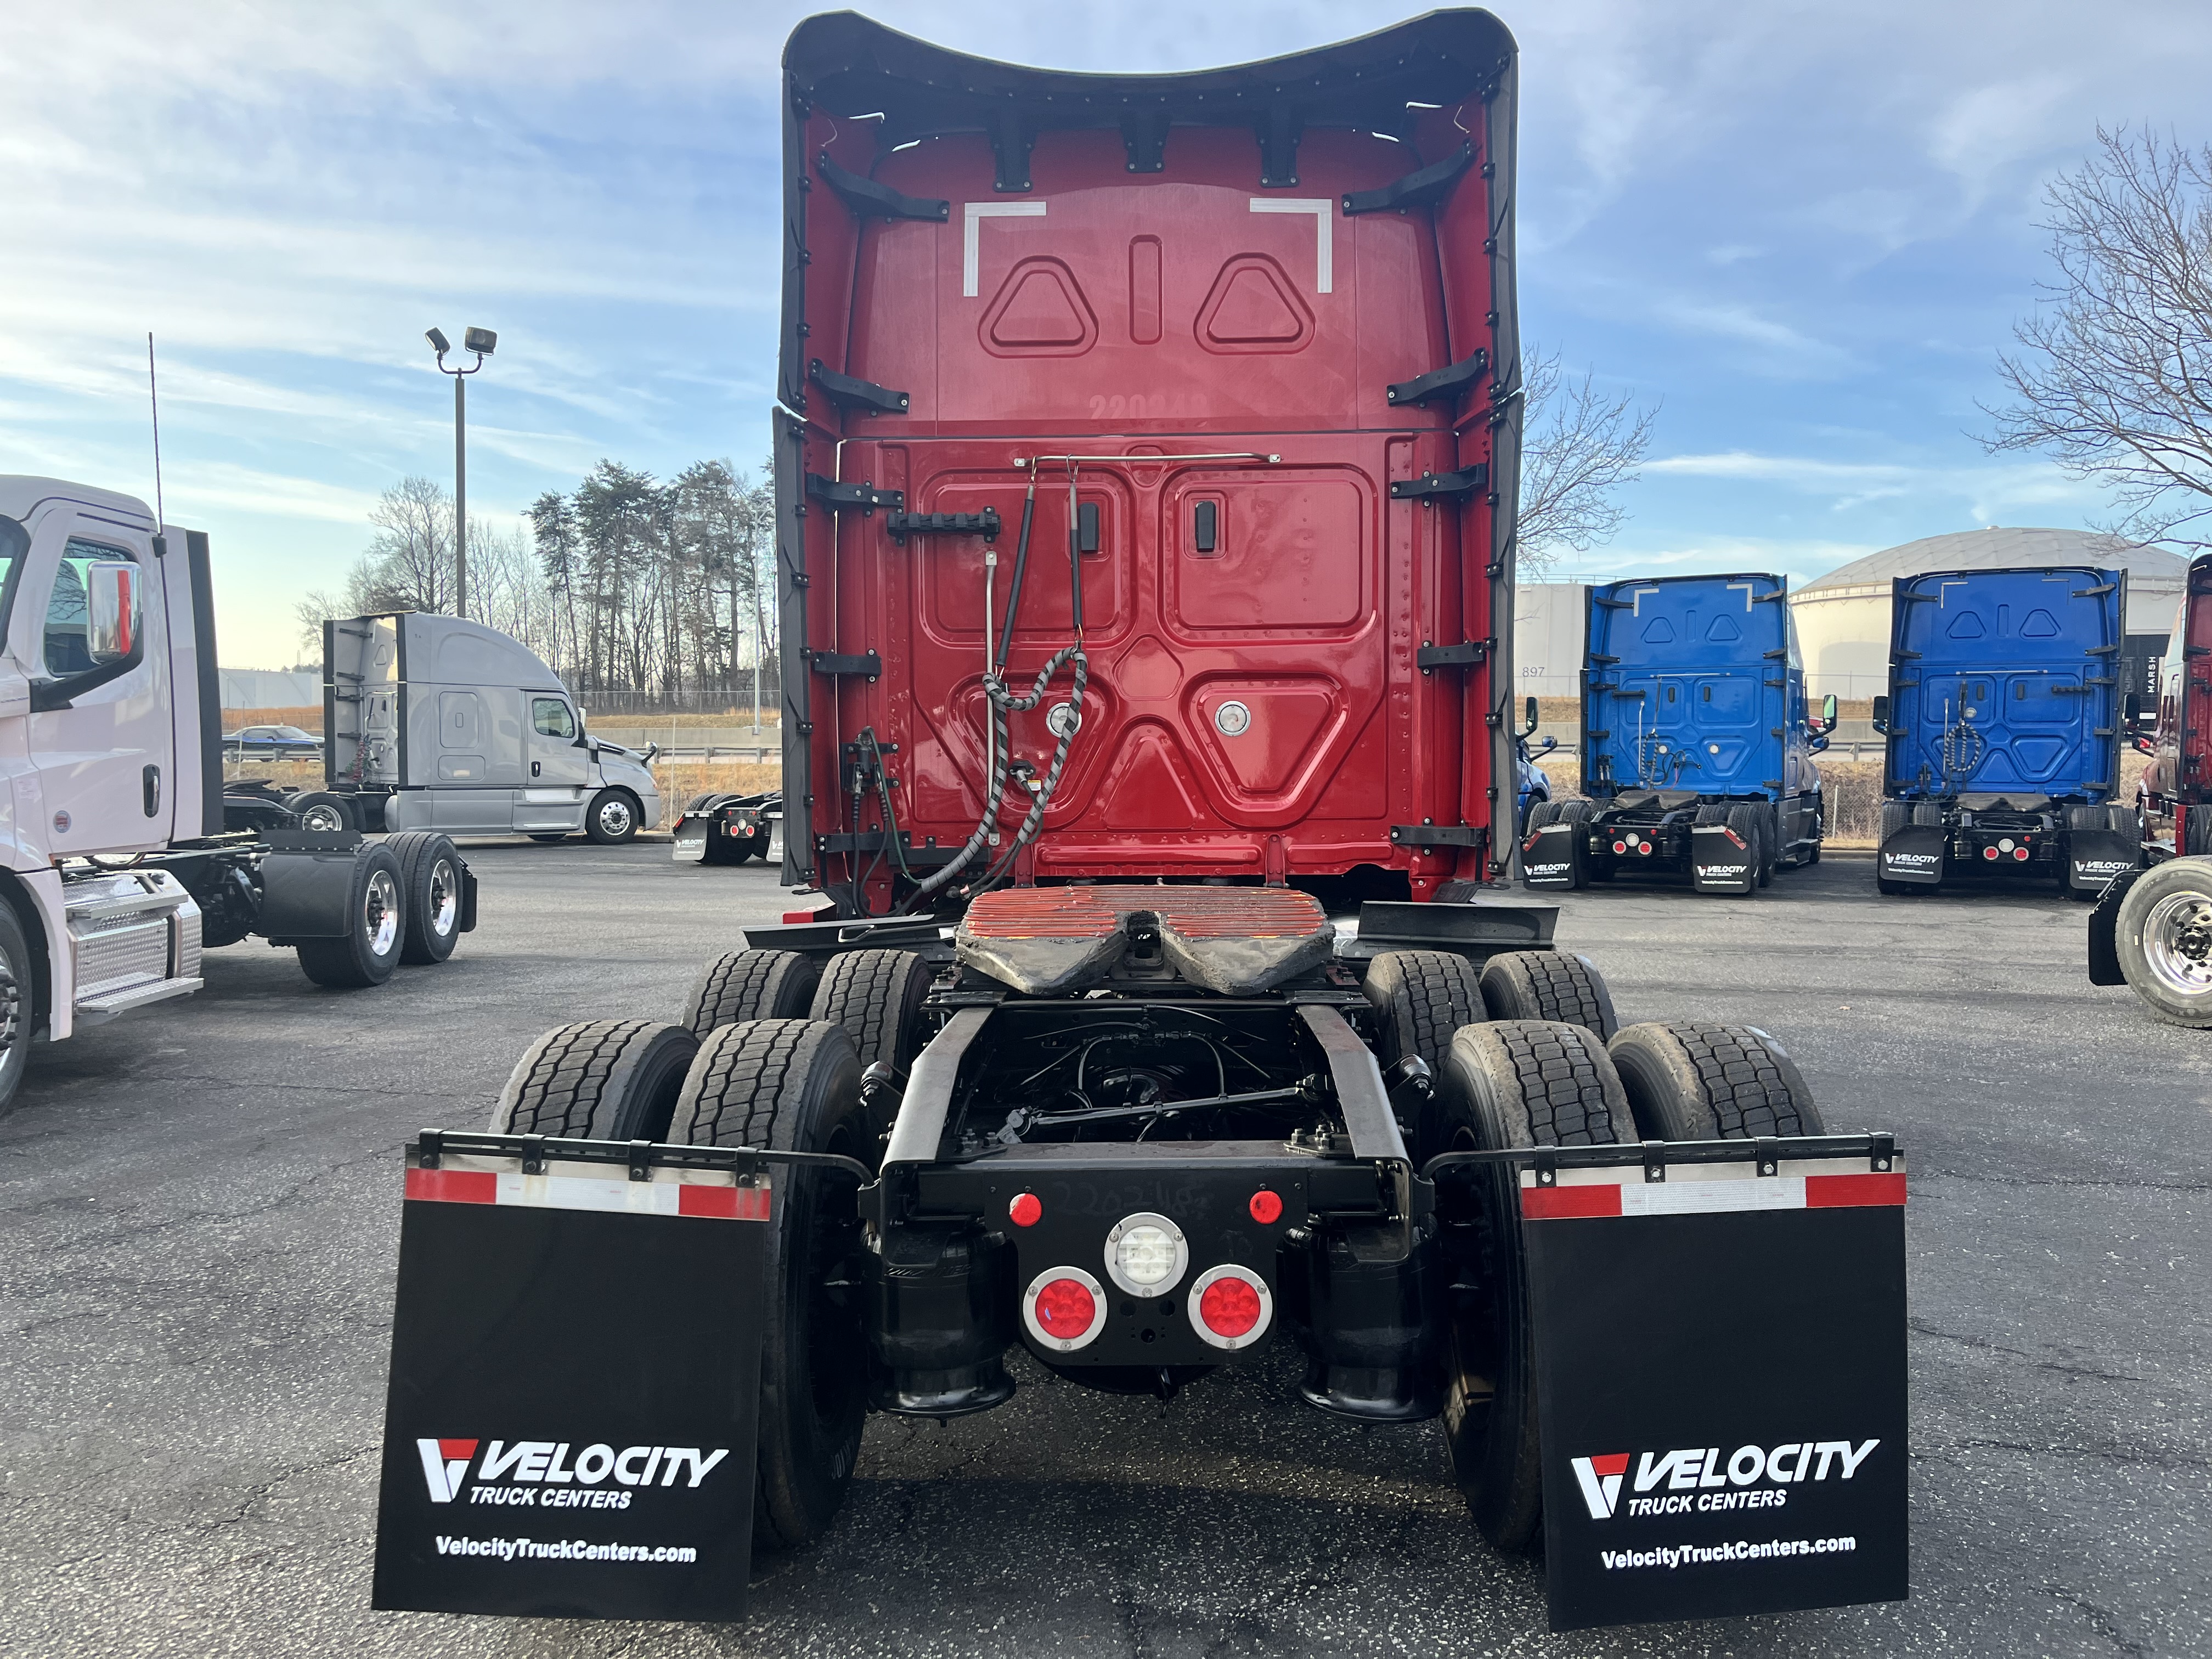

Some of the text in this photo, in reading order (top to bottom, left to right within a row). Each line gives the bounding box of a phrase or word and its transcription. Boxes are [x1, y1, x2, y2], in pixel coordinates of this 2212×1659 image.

[1522, 667, 1545, 677] 897
[2148, 656, 2156, 693] MARSH
[1533, 863, 1571, 872] VELOCITY
[1895, 854, 1939, 864] VELOCITY
[2086, 861, 2134, 870] VELOCITY
[478, 1440, 730, 1488] VELOCITY
[1633, 1438, 1881, 1492] VELOCITY
[470, 1486, 632, 1509] TRUCK CENTERS
[1628, 1488, 1787, 1516] TRUCK CENTERS
[436, 1536, 697, 1562] VelocityTruckCenters.com
[1601, 1536, 1857, 1569] VelocityTruckCenters.com
